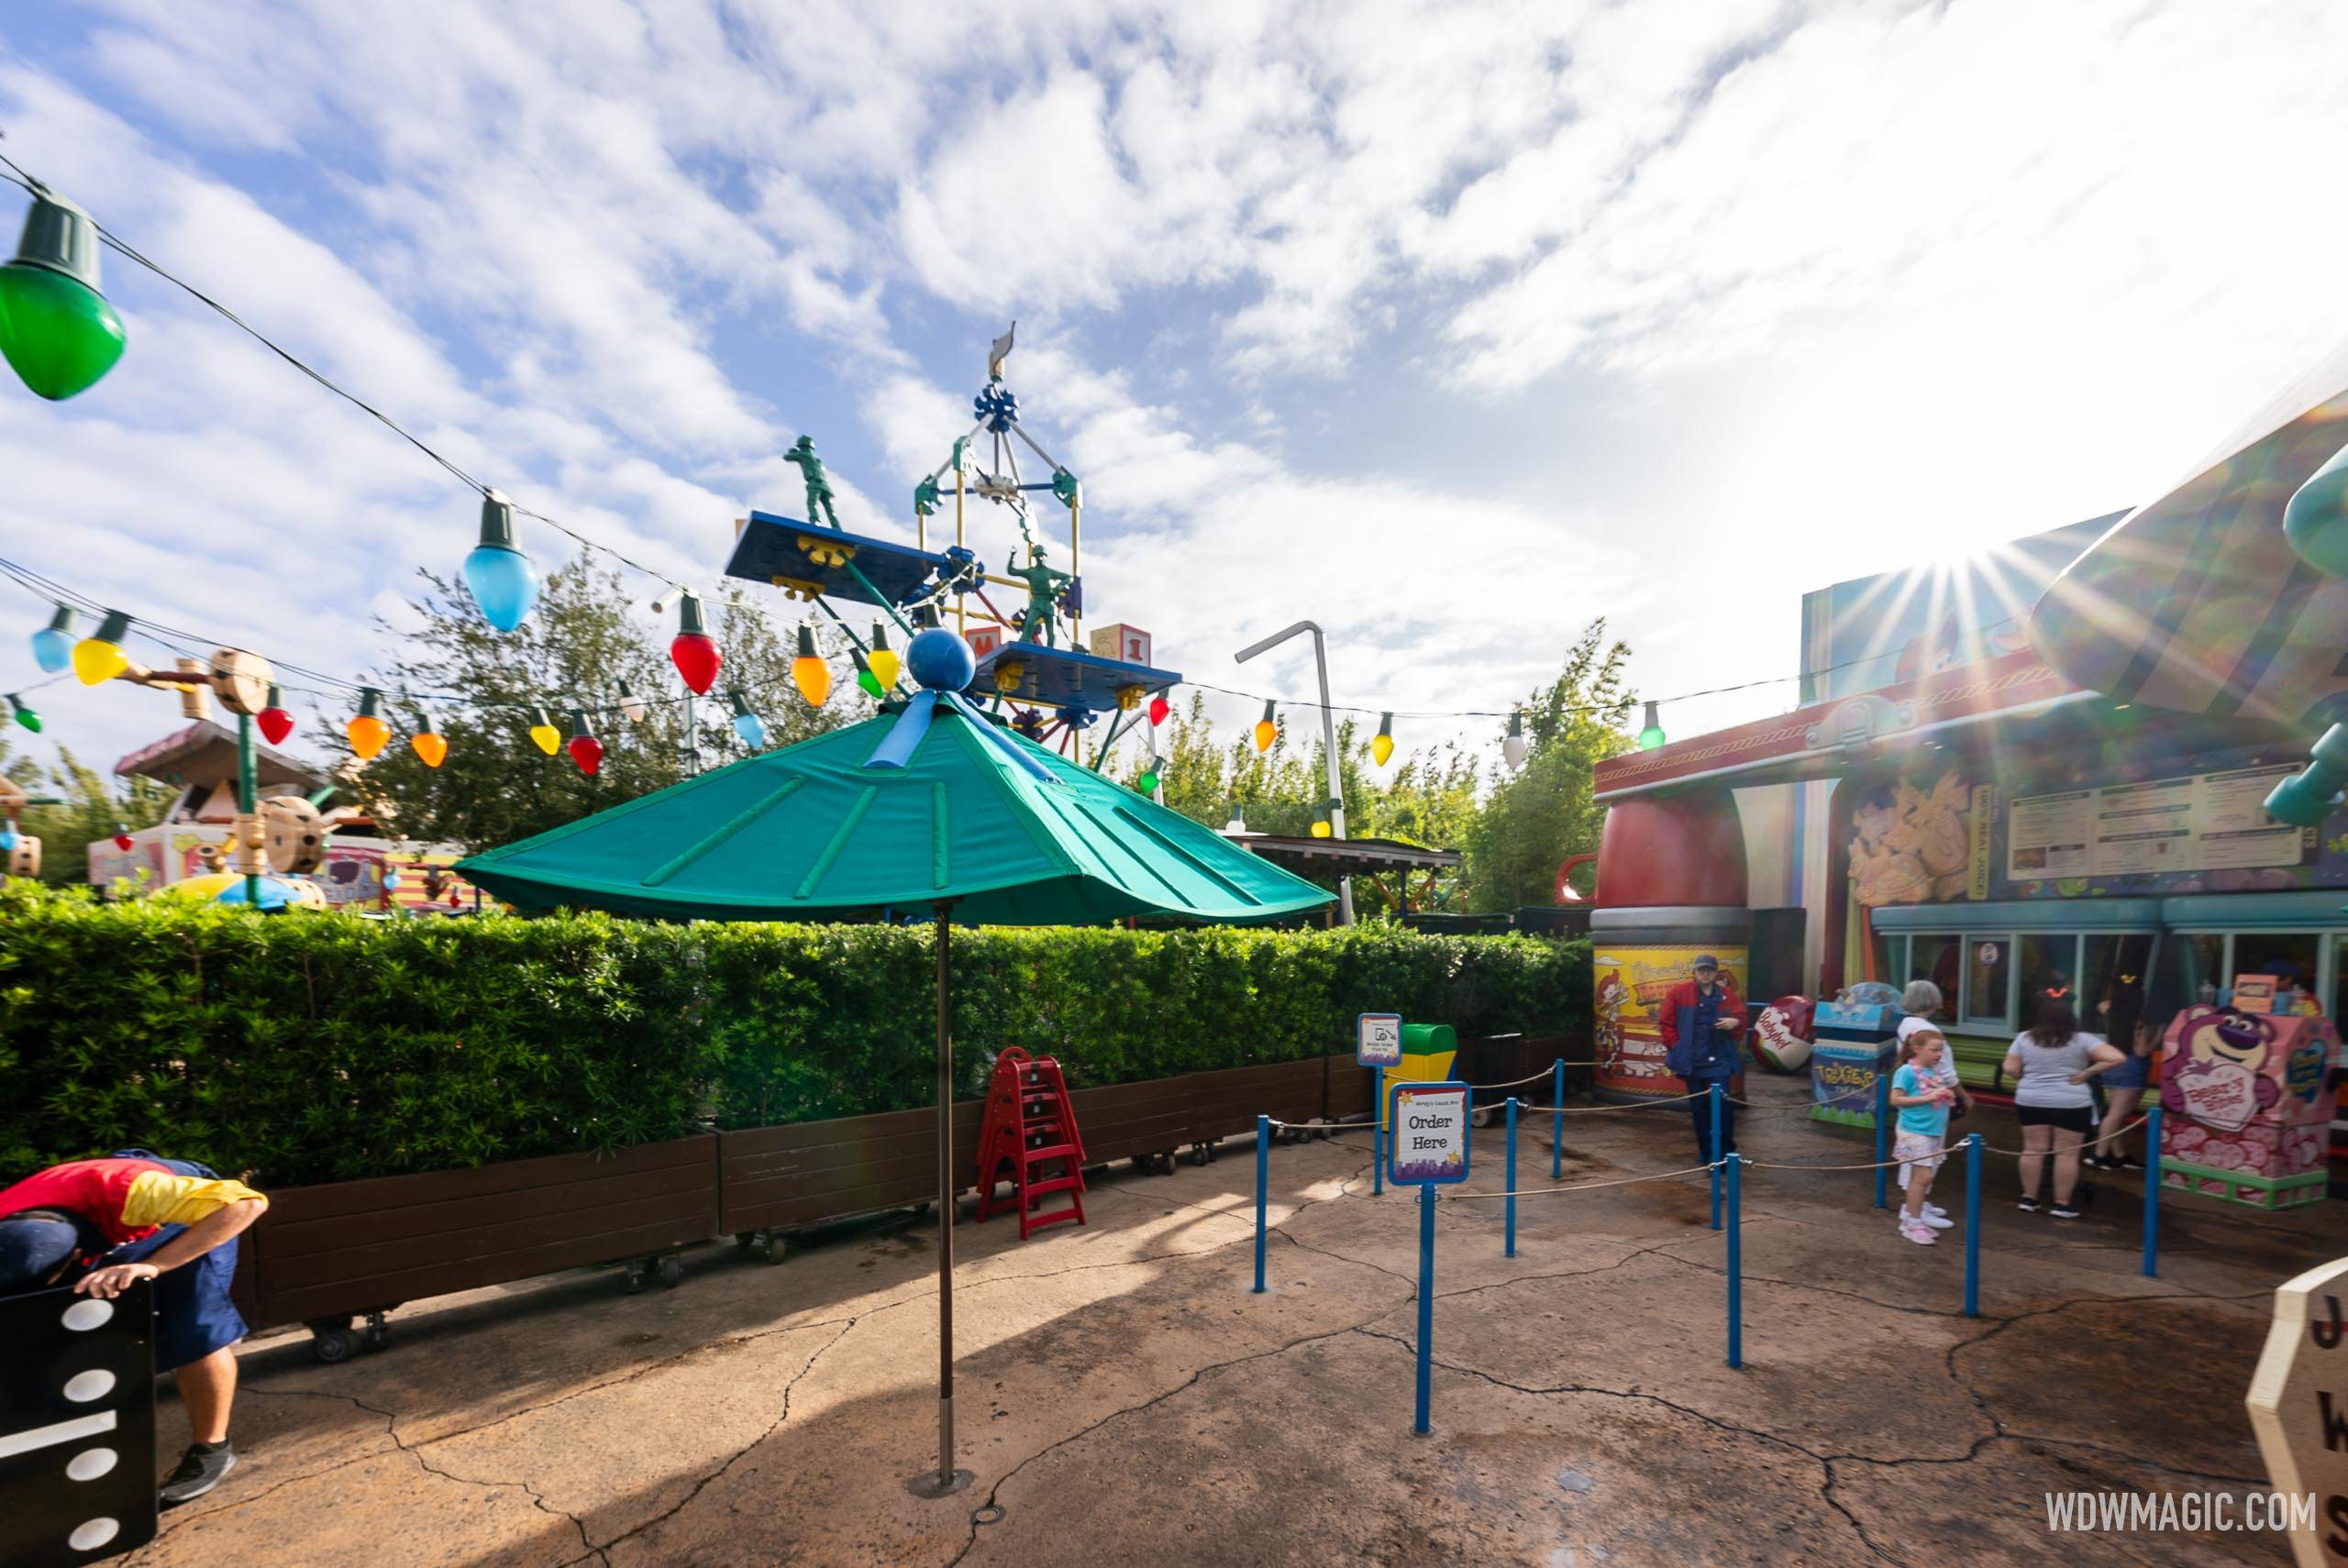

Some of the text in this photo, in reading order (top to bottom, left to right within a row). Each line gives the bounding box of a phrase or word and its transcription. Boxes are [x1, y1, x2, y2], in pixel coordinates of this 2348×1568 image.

[1758, 1011, 1791, 1050] Babybel
[1409, 1114, 1453, 1130] Order
[1412, 1136, 1447, 1150] Here
